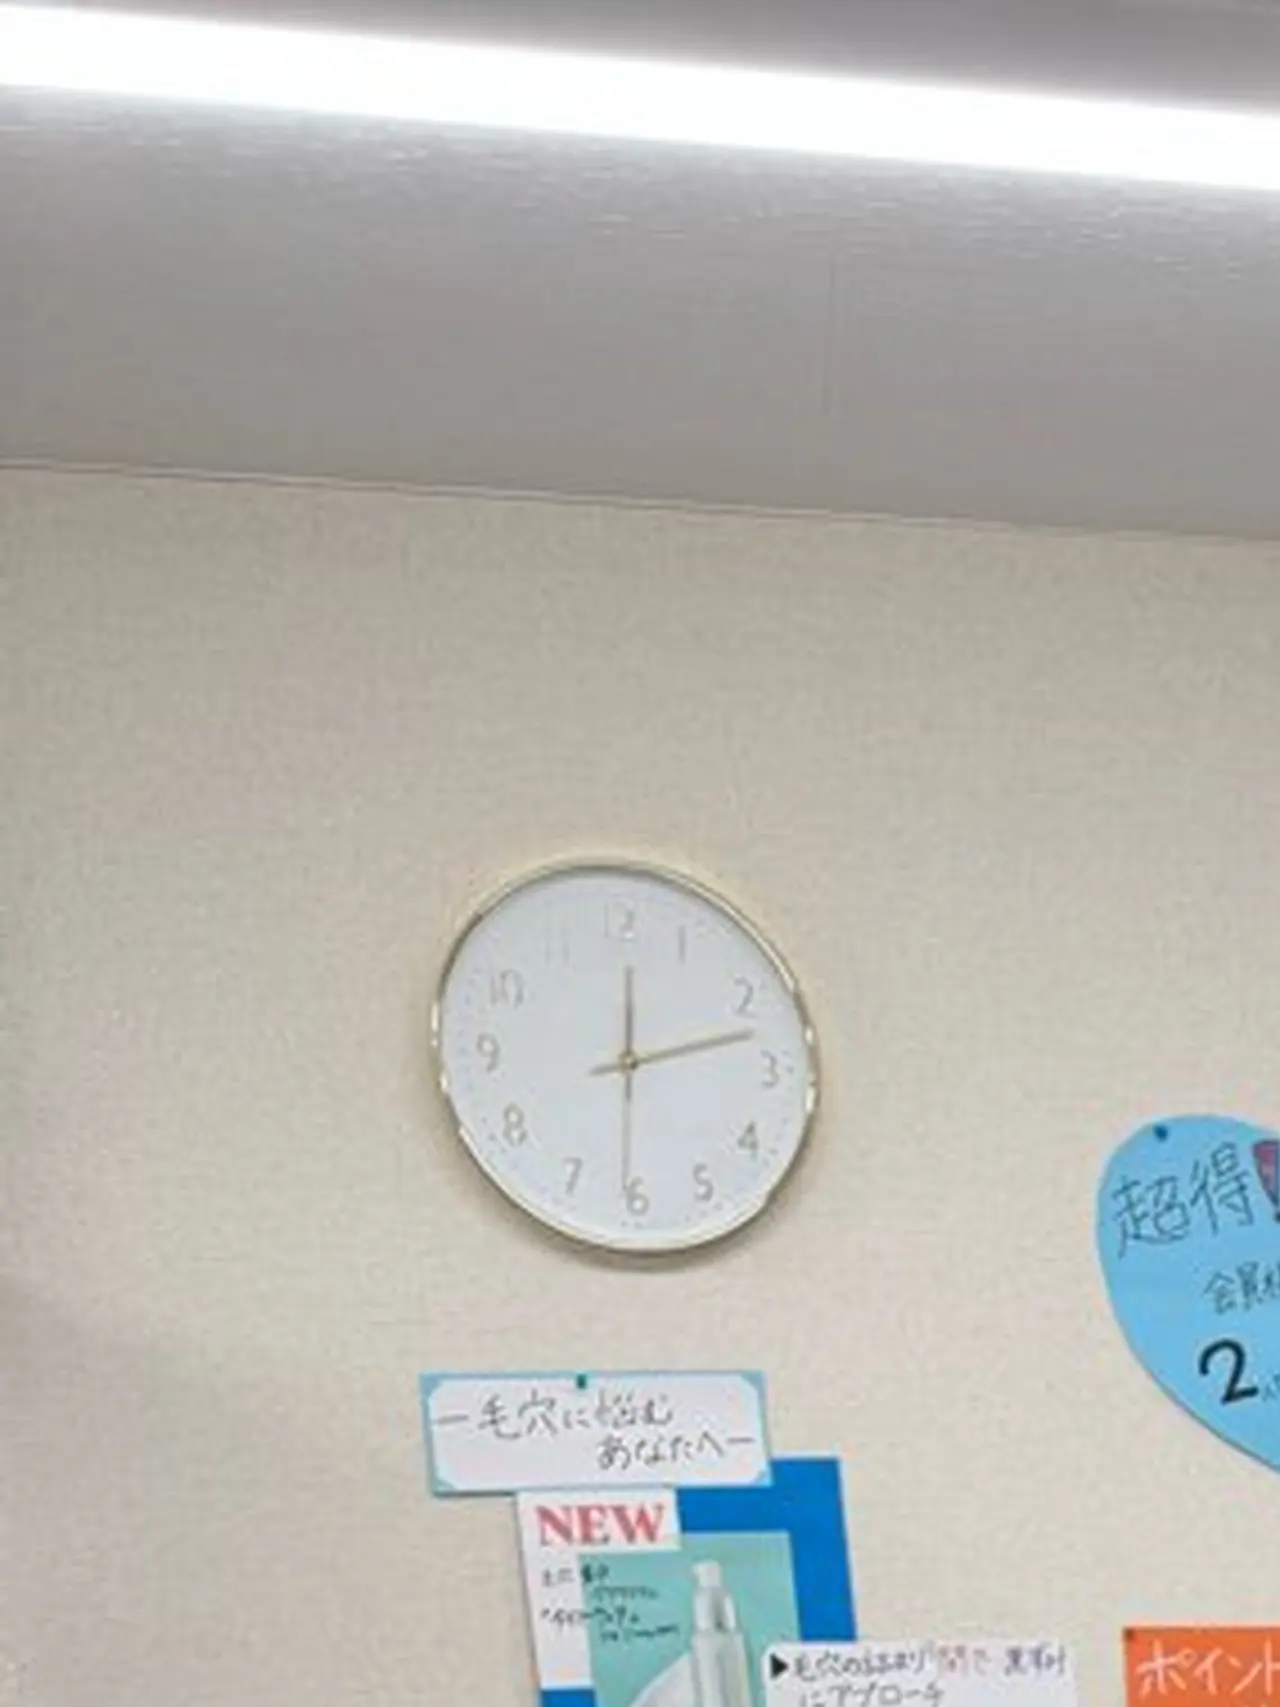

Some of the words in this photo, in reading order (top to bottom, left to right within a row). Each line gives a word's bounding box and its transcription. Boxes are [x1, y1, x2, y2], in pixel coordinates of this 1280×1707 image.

[731, 977, 758, 1017] 2
[475, 1033, 500, 1074] 9
[760, 1050, 782, 1090] 3
[502, 1104, 528, 1147] 8
[735, 1120, 761, 1159] 4
[563, 1157, 584, 1196] 7
[624, 1176, 651, 1217] 6
[692, 1164, 717, 1205] 5
[535, 1504, 667, 1547] NEW
